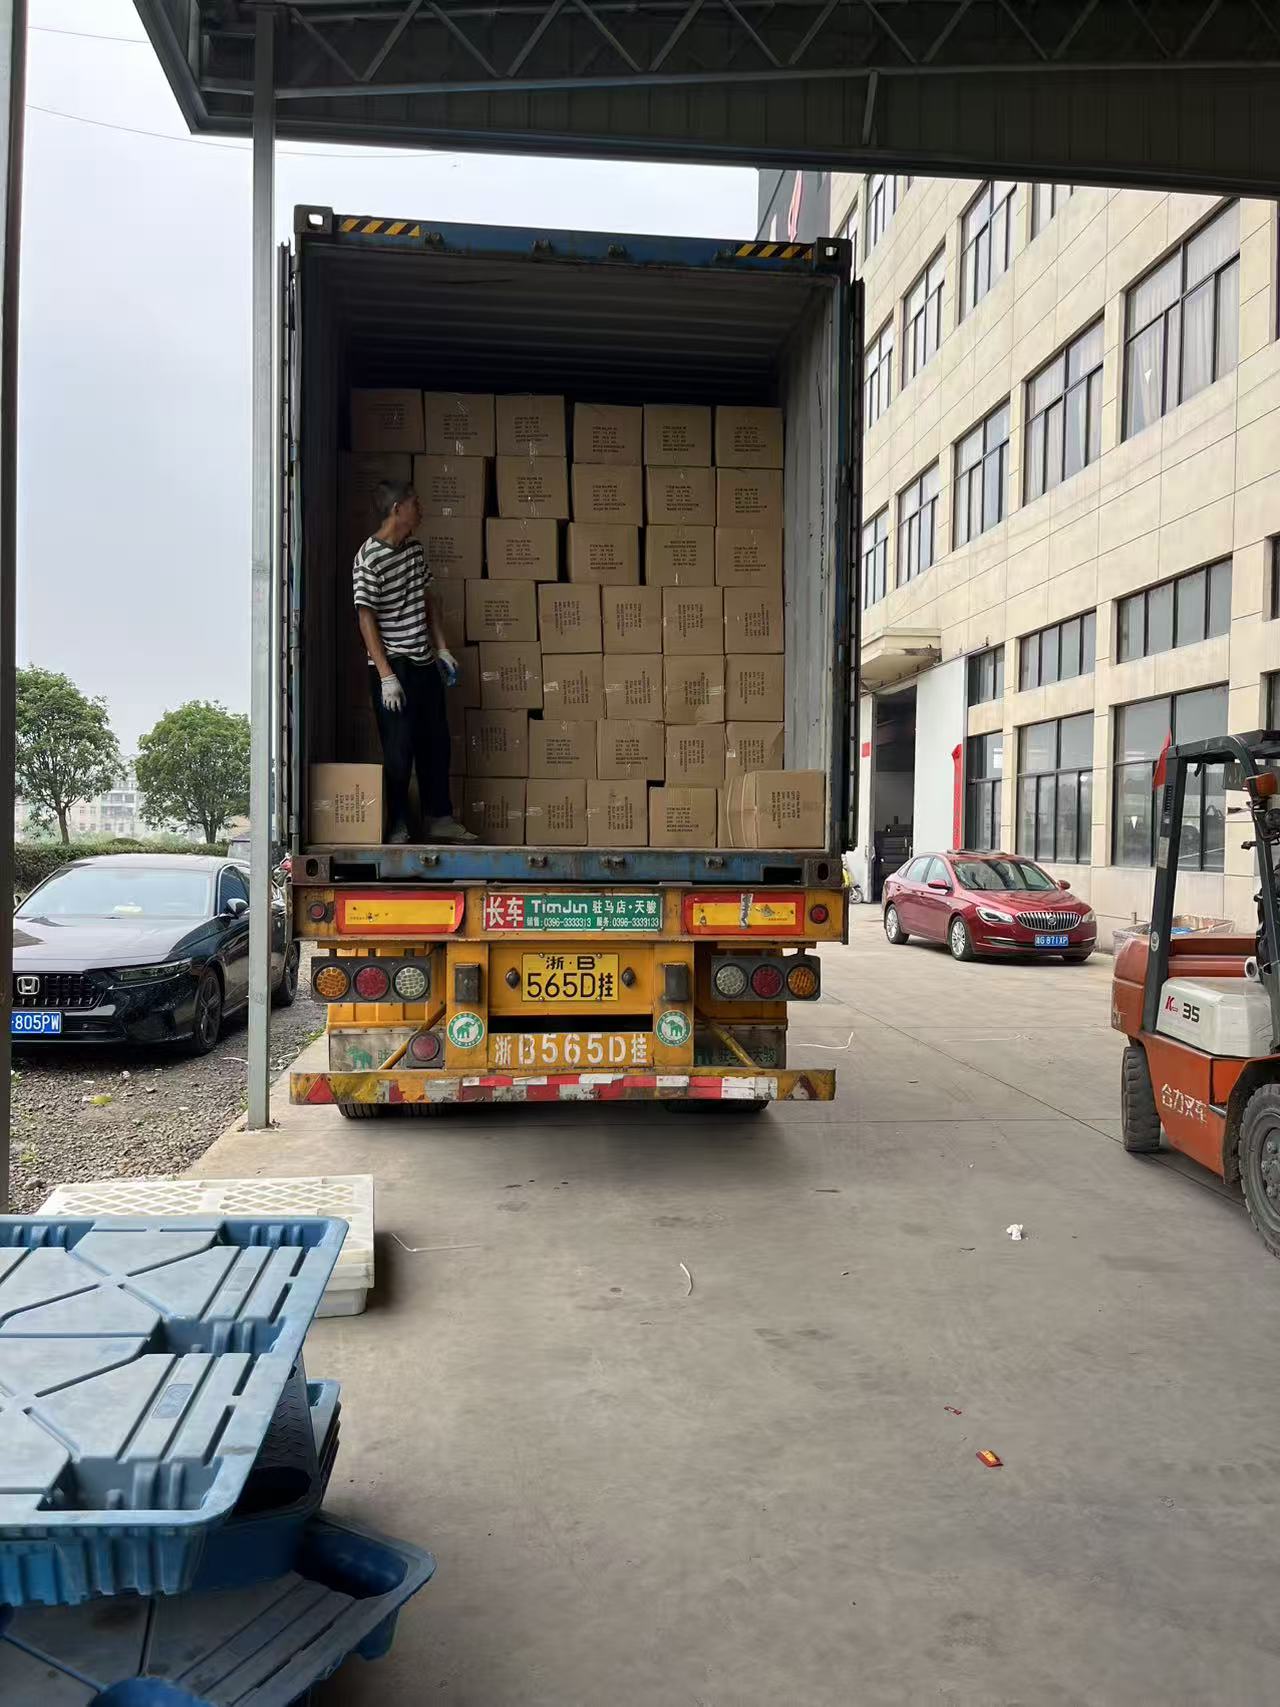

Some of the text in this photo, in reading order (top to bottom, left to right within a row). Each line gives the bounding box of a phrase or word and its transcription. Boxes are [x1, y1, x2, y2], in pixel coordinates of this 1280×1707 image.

[486, 896, 524, 927] 长车
[527, 972, 614, 998] 565D挂
[1182, 1002, 1200, 1023] 35
